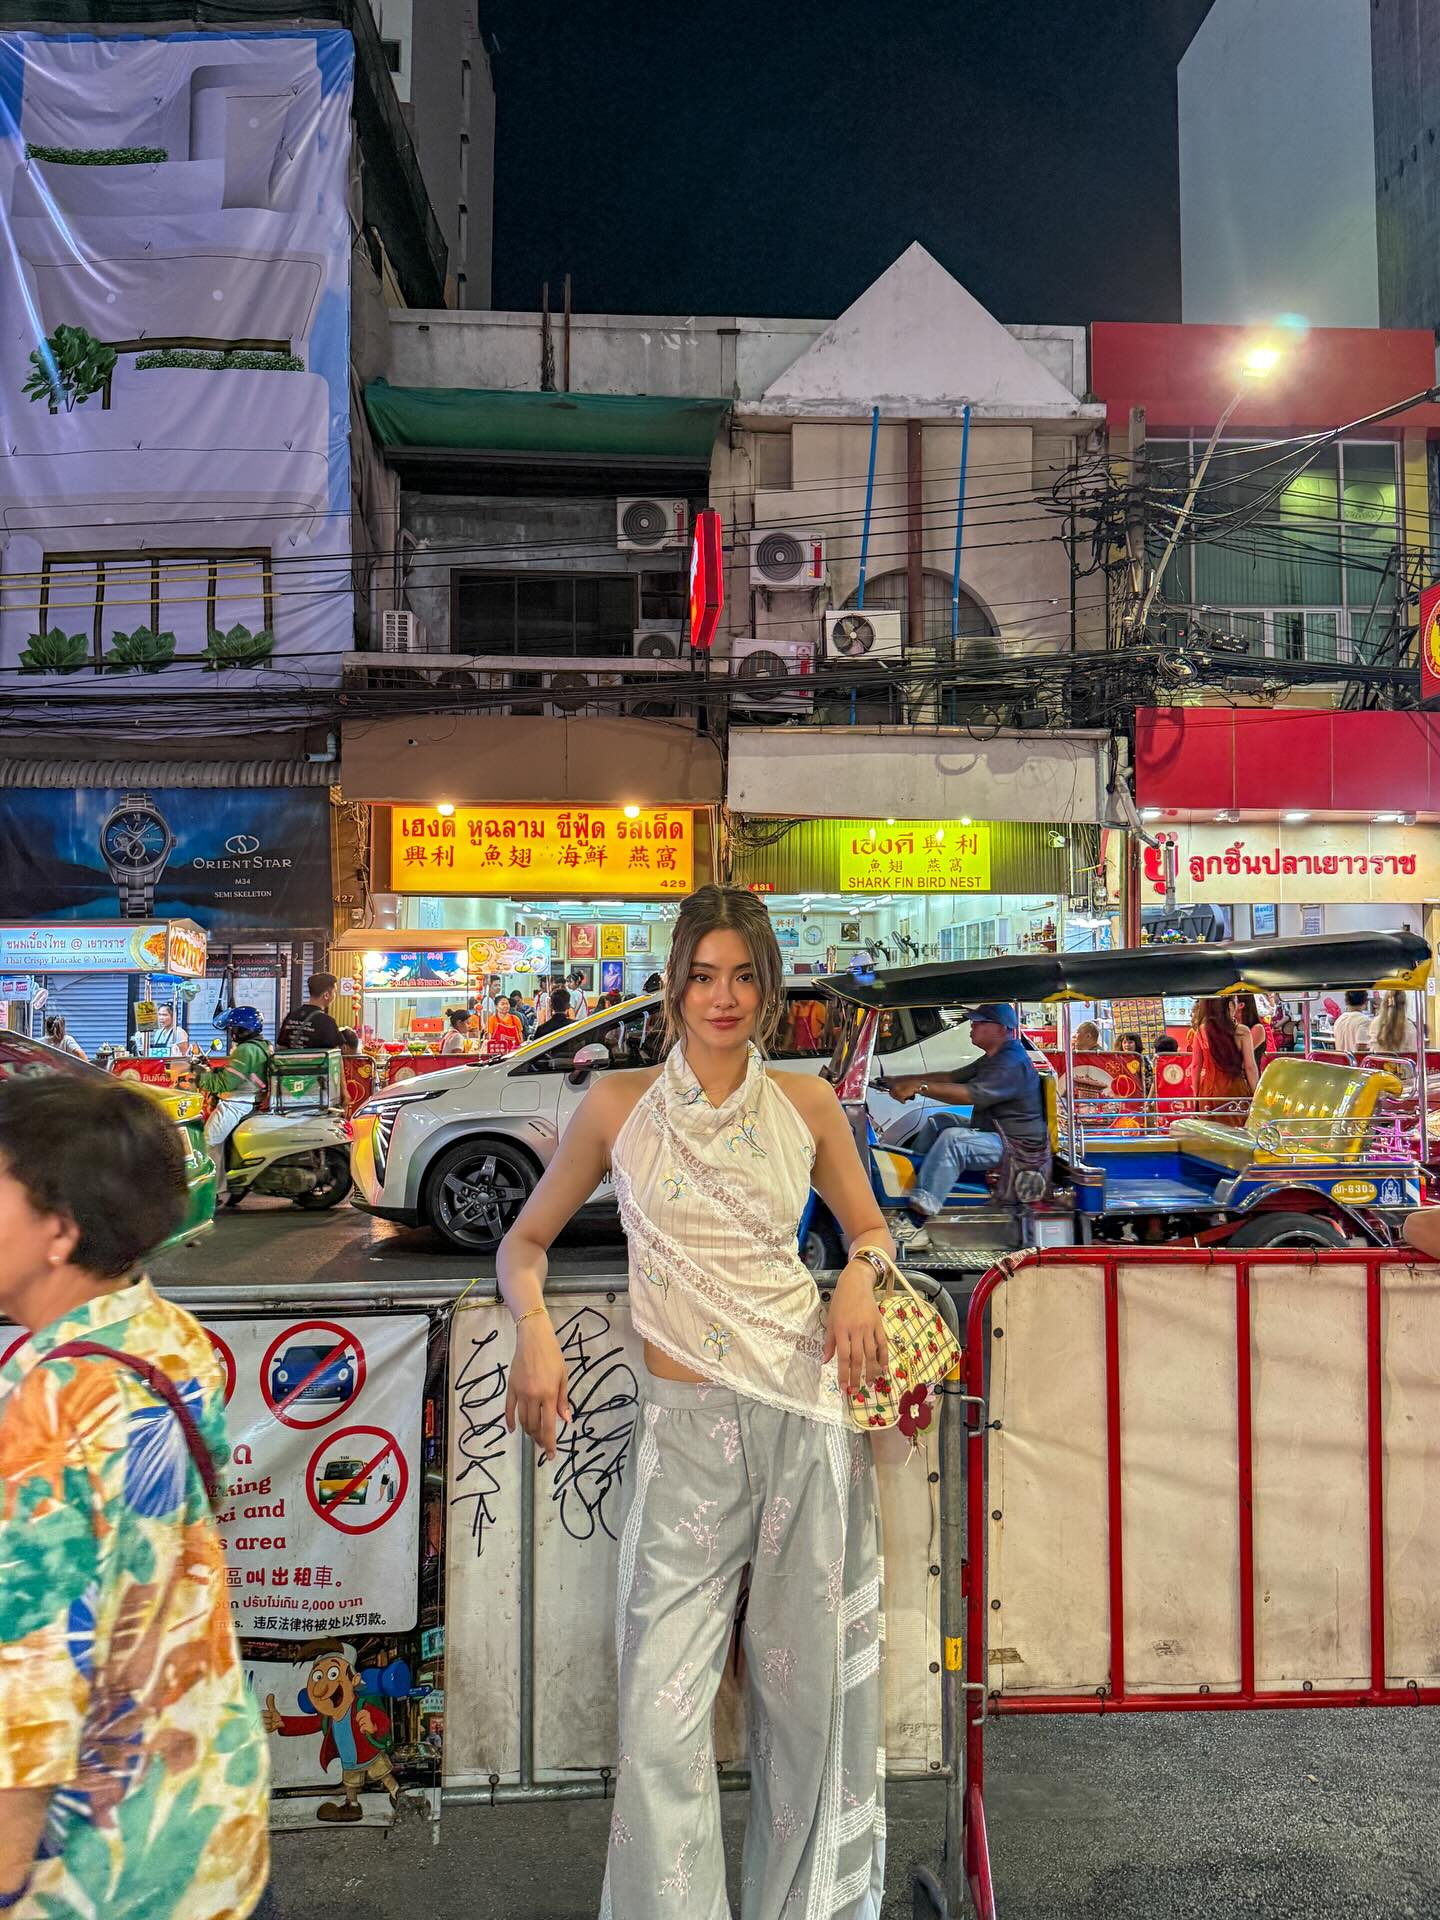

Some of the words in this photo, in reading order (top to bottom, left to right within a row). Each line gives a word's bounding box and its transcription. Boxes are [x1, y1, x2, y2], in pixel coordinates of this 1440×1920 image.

[467, 818, 545, 846] หูฉลาม
[556, 812, 606, 847] ซีฟู้ด
[616, 812, 684, 839] รสเด็ด
[403, 846, 455, 868] 興利
[480, 845, 533, 868] 魚翅
[557, 845, 610, 869] 海鮮
[628, 845, 678, 871] 燕窩
[868, 858, 904, 873] 魚翅
[1188, 841, 1417, 882] ลูกชิ้นปลาเยาวราช
[660, 880, 687, 888] 429
[752, 883, 771, 891] 431
[848, 876, 891, 888] SHARK
[894, 876, 914, 888] FIN
[917, 876, 946, 888] BIRD
[950, 876, 982, 888] NEST
[233, 889, 272, 898] SKELETON
[334, 895, 354, 903] 427
[71, 937, 82, 950] @
[87, 936, 126, 949] เยาวราช
[4, 955, 22, 965] Thai
[24, 956, 49, 967] Crispy
[51, 956, 82, 965] Pancake
[93, 955, 127, 965] Yaowarat
[243, 1498, 285, 1518] and
[235, 1536, 287, 1551] area
[243, 1595, 299, 1610] ปรับไม่เกิน
[301, 1599, 335, 1612] 2,000
[338, 1597, 364, 1609] บาท
[253, 1612, 387, 1632] 违反法律将被处以罚款。
